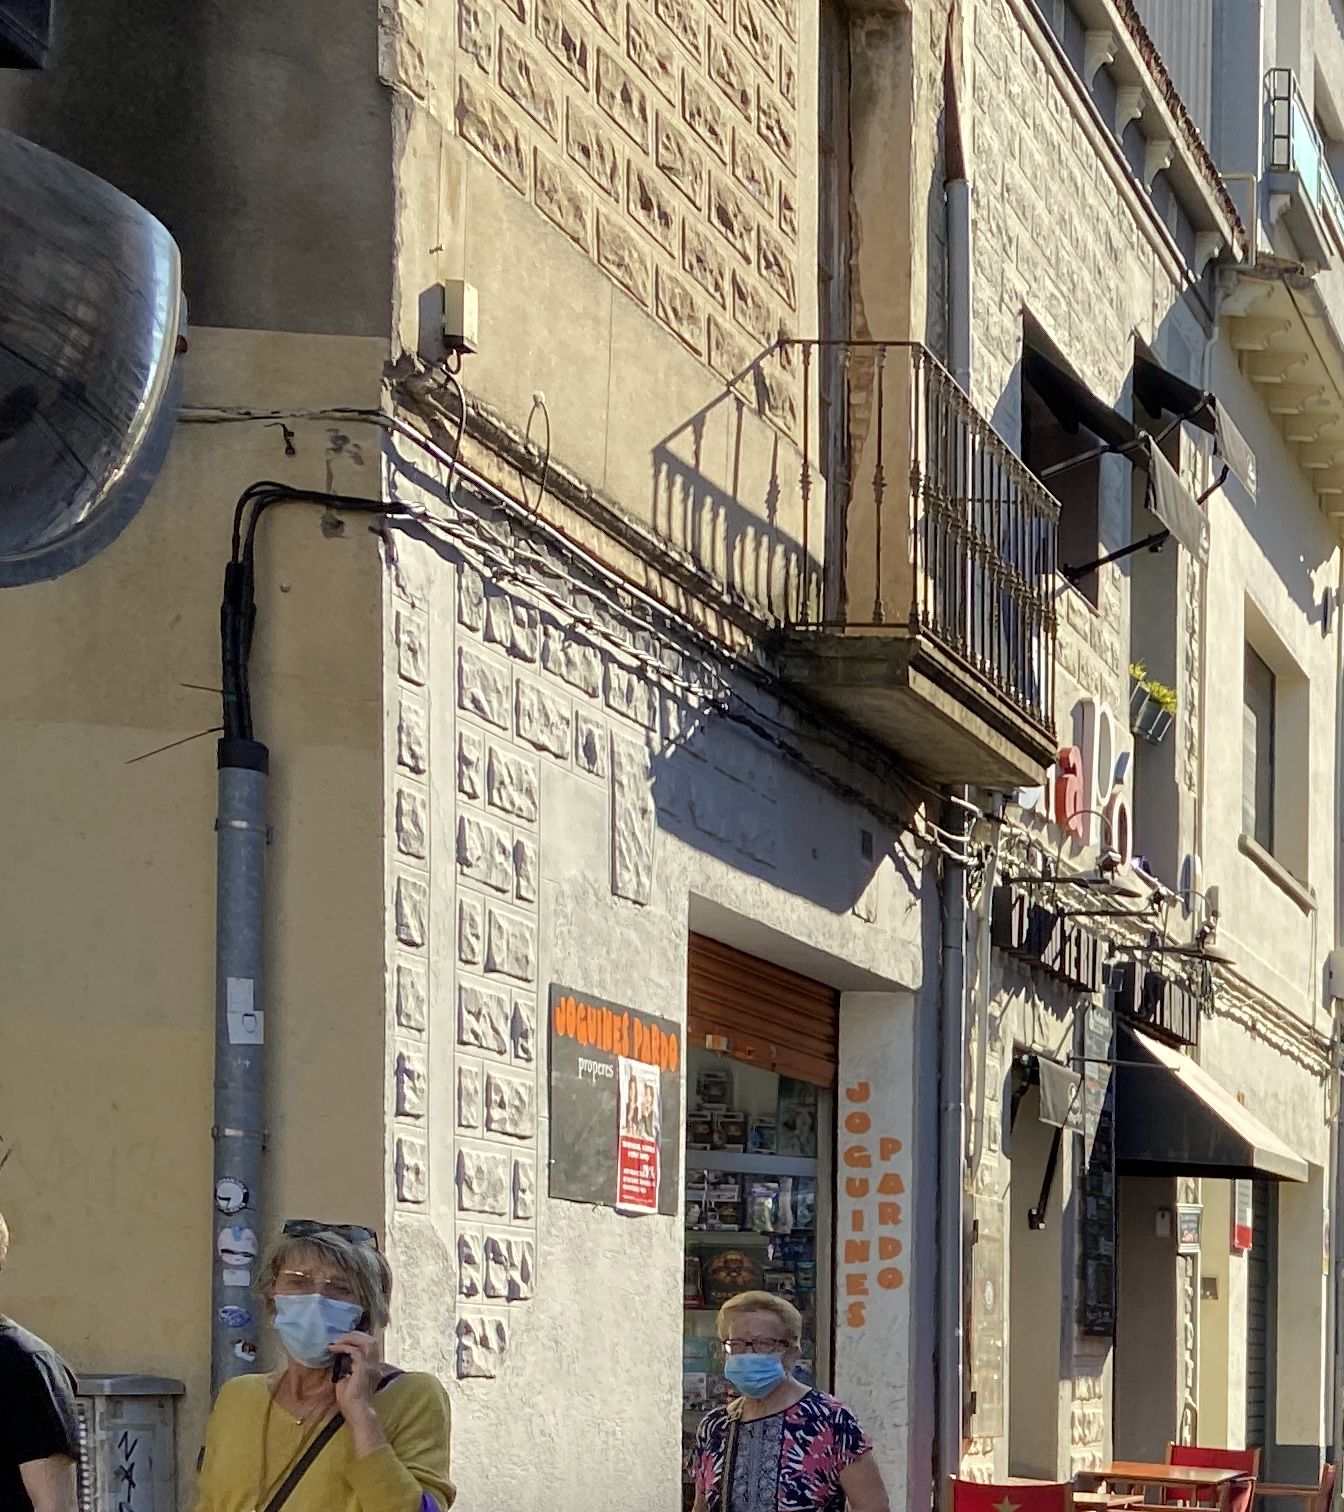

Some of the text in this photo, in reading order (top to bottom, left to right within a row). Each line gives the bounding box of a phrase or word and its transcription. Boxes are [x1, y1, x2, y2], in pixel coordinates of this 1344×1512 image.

[554, 995, 678, 1073] JOGUINES PARDO
[843, 1082, 873, 1328] JOGUINES
[877, 1137, 905, 1290] PARDO
